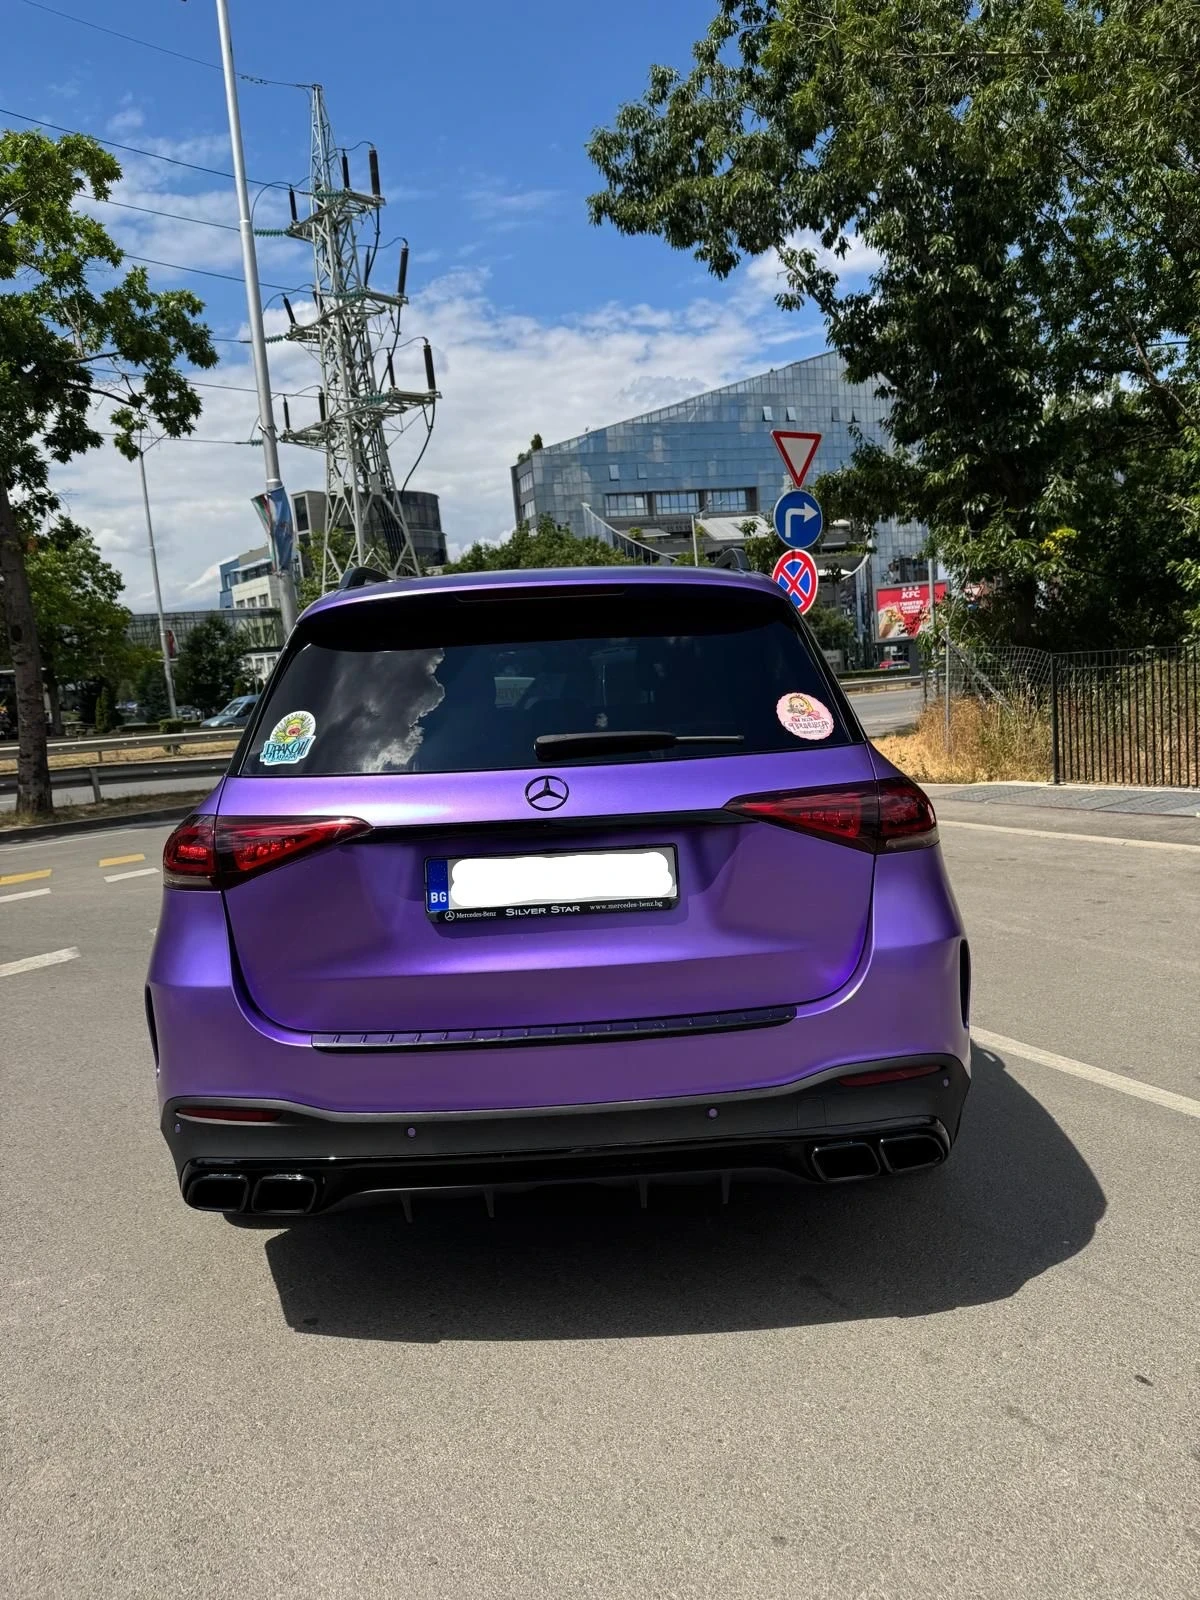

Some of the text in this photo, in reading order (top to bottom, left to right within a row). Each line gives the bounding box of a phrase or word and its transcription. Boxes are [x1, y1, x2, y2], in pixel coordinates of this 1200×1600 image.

[901, 590, 921, 599] KFC
[430, 891, 447, 904] BG
[505, 905, 580, 917] SILVER STAR
[589, 900, 663, 911] www.mercedes-benz.bg
[456, 910, 497, 919] Mercedes-Benz
